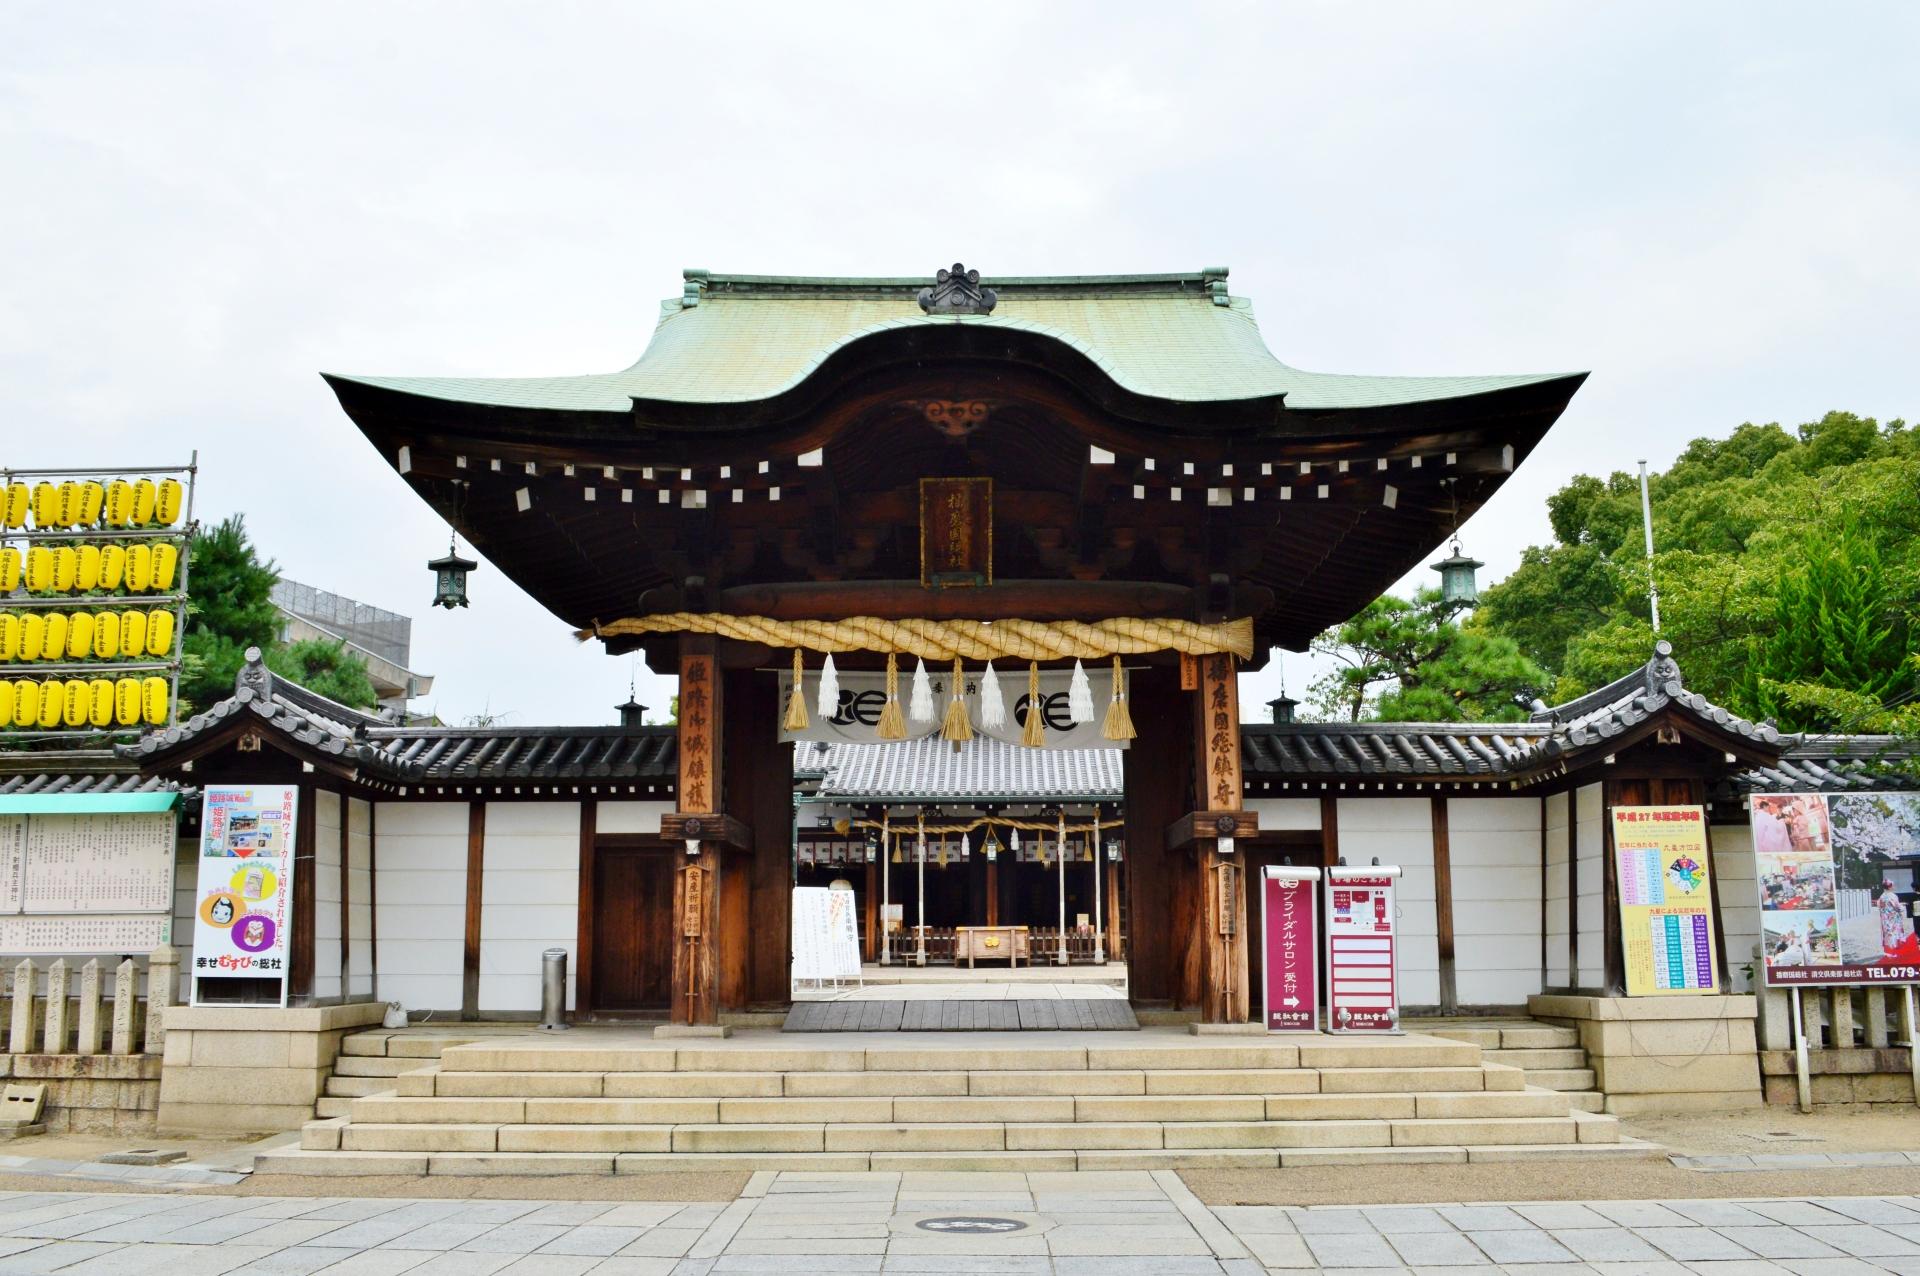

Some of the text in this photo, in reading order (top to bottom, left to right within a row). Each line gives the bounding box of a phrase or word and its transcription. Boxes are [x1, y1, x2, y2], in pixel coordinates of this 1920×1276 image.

[1283, 891, 1298, 994] ブライダルサロン 受付
[196, 954, 282, 971] 幸せむすびの総社
[1866, 967, 1920, 979] TEL.079-
